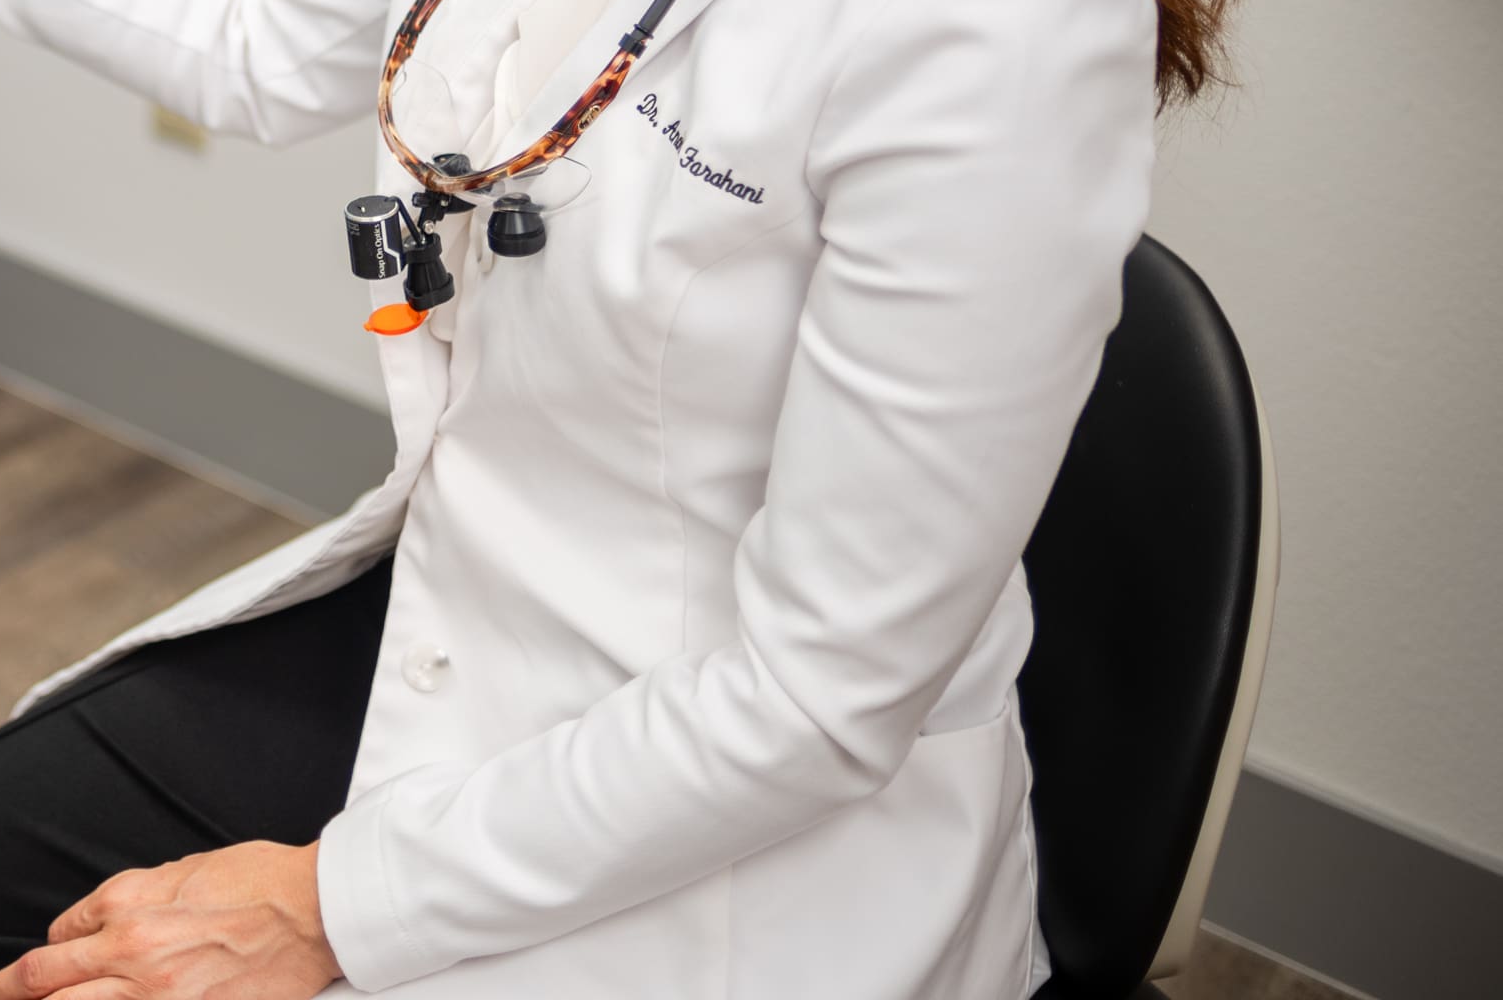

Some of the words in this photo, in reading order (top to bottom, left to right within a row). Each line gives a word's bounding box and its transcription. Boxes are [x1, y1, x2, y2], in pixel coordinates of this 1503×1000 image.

[636, 93, 658, 128] Dr.
[679, 146, 765, 205] Farahani
[374, 224, 383, 247] Optics
[376, 248, 384, 259] On
[378, 260, 386, 279] Snap
